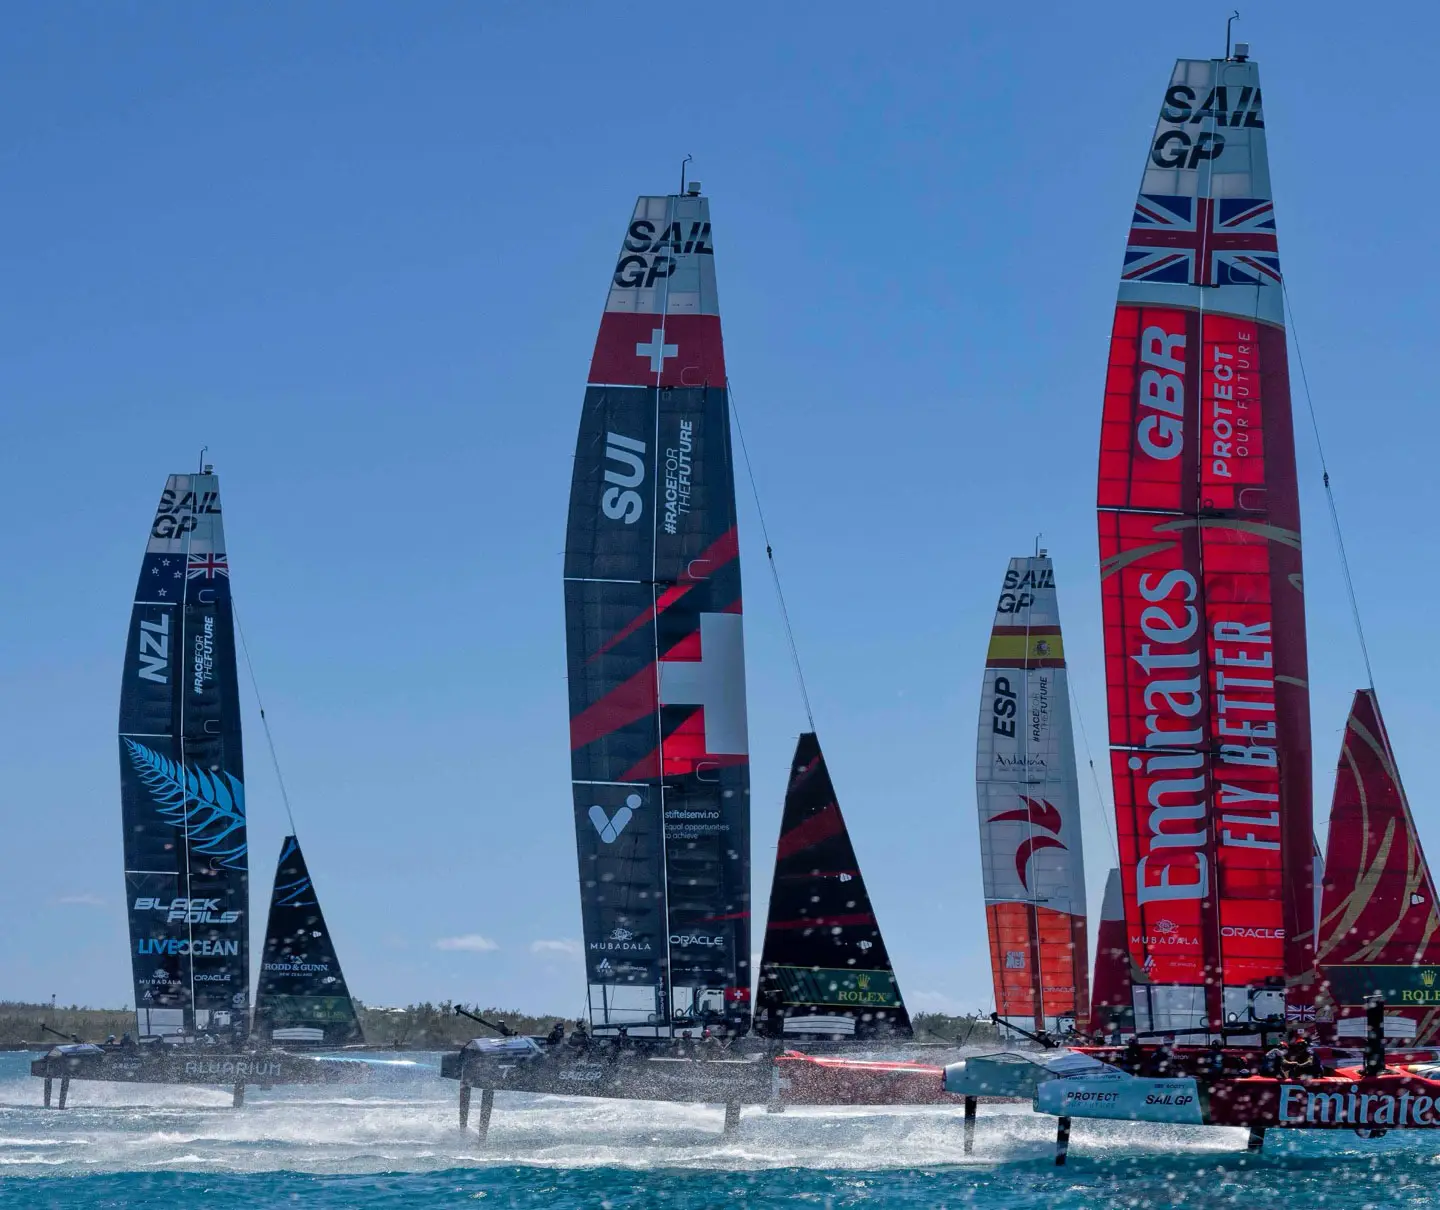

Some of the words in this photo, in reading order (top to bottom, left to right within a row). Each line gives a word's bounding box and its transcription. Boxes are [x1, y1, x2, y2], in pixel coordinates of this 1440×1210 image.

[1160, 85, 1265, 129] SAIL
[1151, 130, 1226, 169] GP
[623, 220, 714, 255] SAIL
[614, 255, 678, 288] GP
[1237, 333, 1251, 410] FUTURE
[1137, 326, 1187, 461] GBR
[1212, 347, 1234, 478] PROTECT
[1236, 418, 1249, 457] OUR
[602, 431, 646, 525] SUI
[157, 490, 222, 514] SAIL
[151, 515, 198, 539] GP
[1003, 569, 1056, 589] SAIL
[997, 593, 1035, 614] GP
[138, 613, 169, 684] NZL
[993, 677, 1017, 738] ESP
[1213, 620, 1278, 768] BETTER
[1128, 569, 1210, 907] Emirates
[1219, 783, 1281, 851] FLY
[134, 897, 221, 911] BLACK
[167, 910, 240, 924] FOILS
[669, 935, 723, 945] ORACLE
[1131, 936, 1199, 945] MUBADALA
[1221, 927, 1285, 939] ORACLE
[265, 963, 291, 971] RODD
[292, 963, 299, 971] &
[838, 990, 887, 1003] ROLEX
[1067, 1091, 1119, 1102] PROTECT
